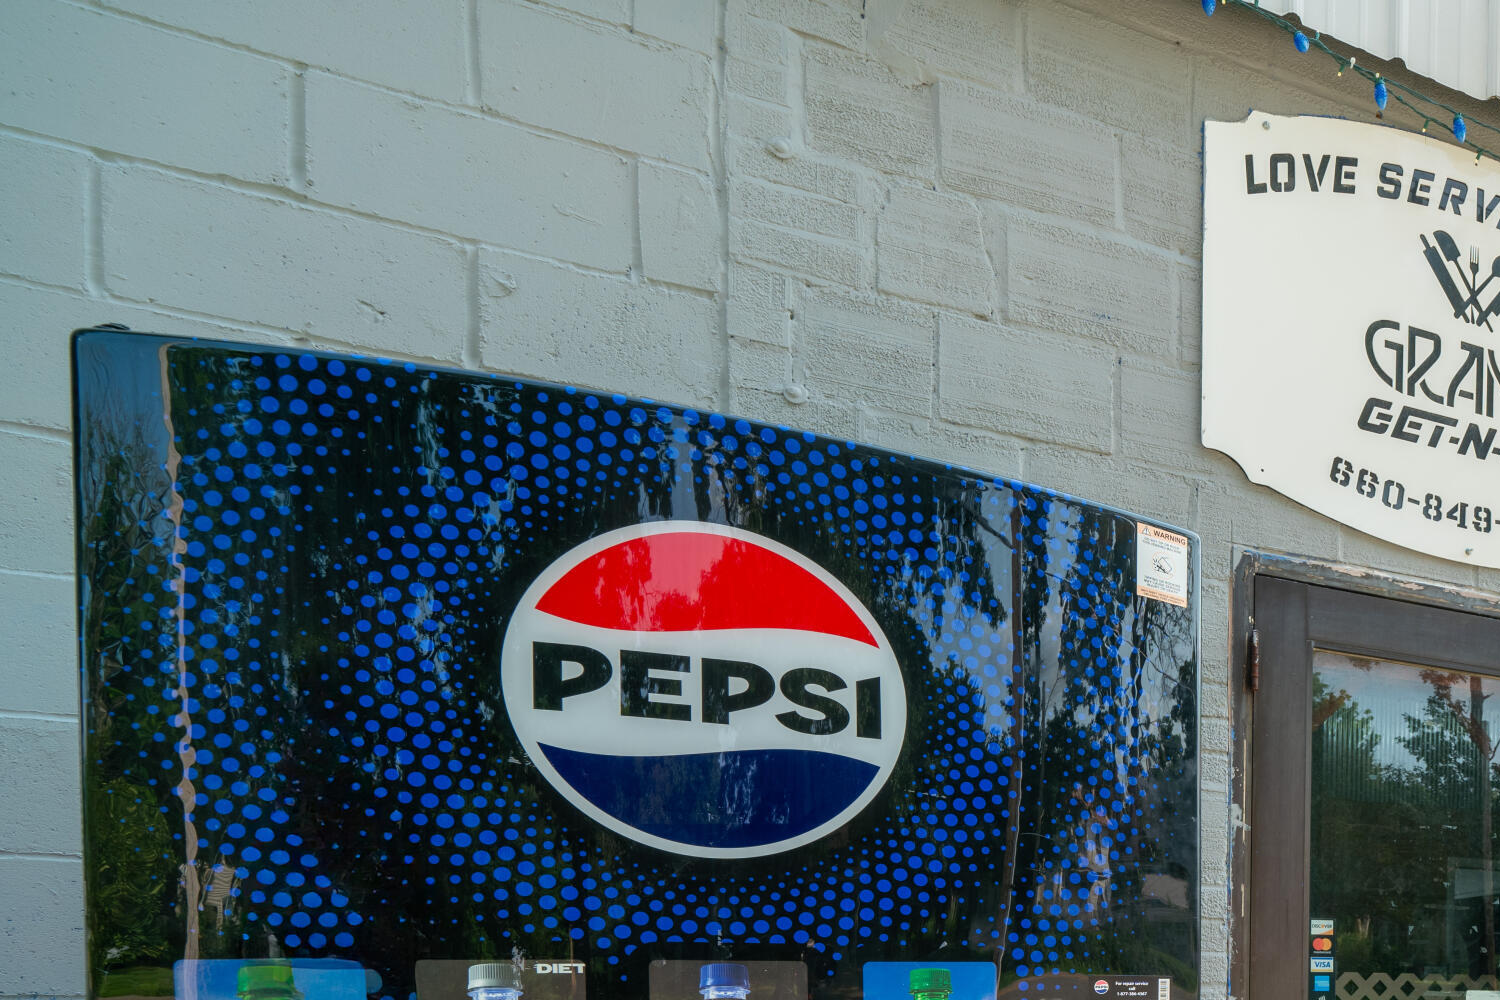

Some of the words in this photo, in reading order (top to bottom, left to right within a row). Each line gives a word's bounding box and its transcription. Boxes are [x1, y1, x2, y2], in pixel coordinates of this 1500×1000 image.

[1245, 153, 1358, 195] LOVE
[1153, 529, 1186, 546] WARNING
[532, 641, 882, 740] PEPSI
[535, 963, 586, 974] DIET
